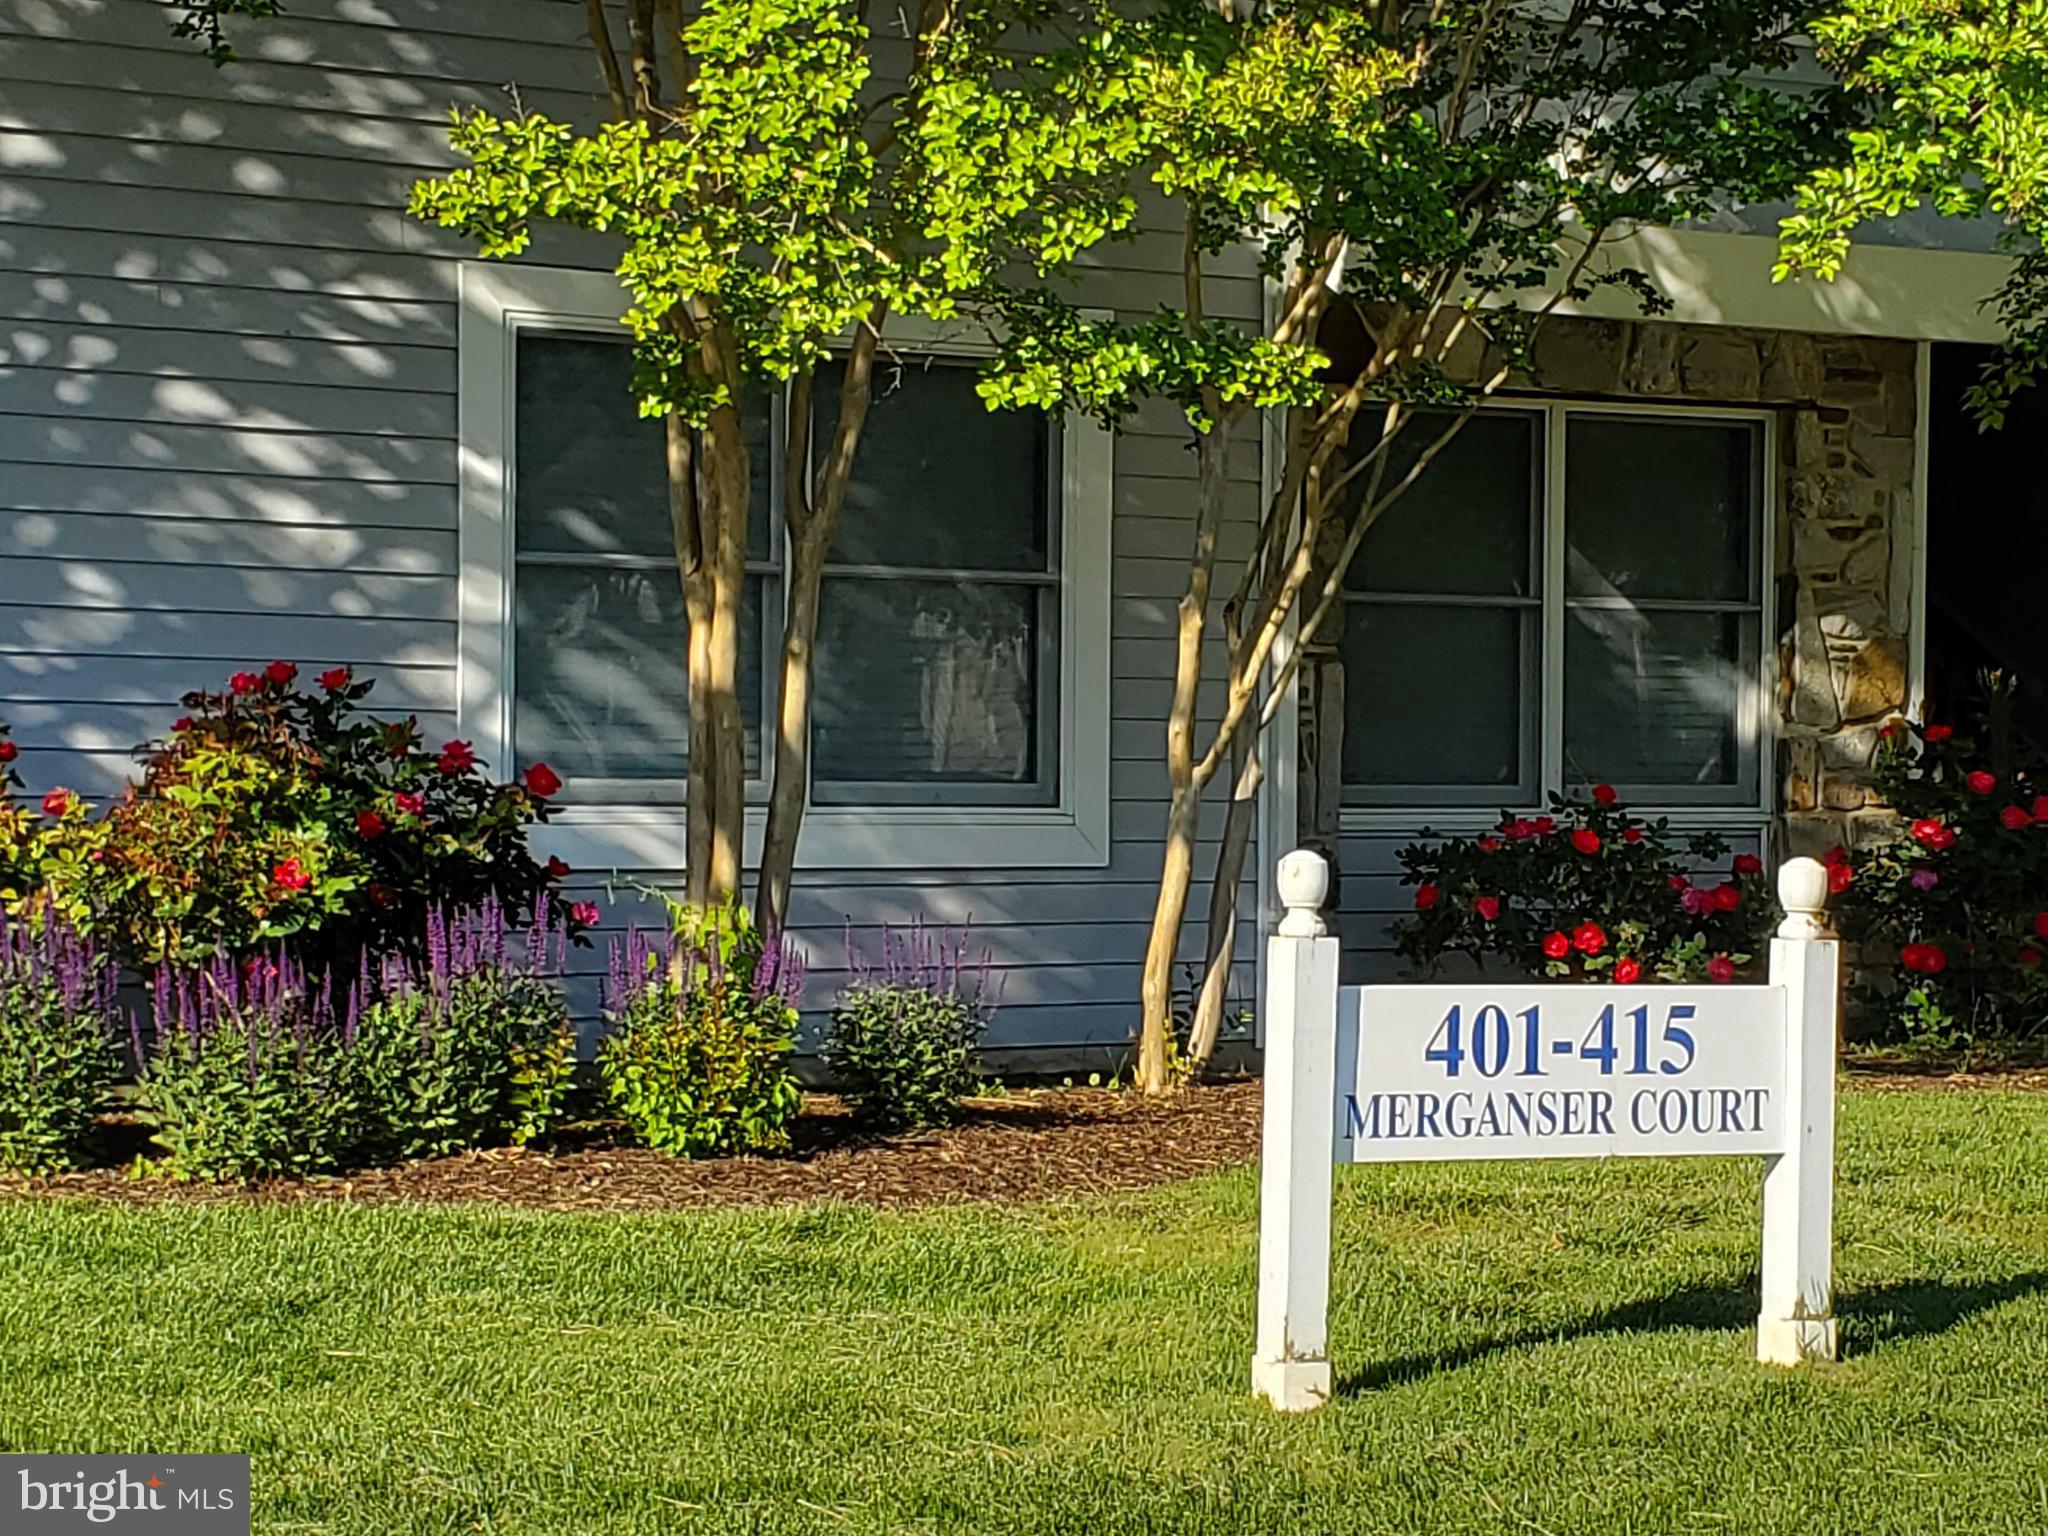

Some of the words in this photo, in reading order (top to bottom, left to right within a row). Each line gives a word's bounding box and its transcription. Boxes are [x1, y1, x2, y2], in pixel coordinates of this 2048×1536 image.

[1424, 1002, 1697, 1078] 401-415
[1342, 1090, 1616, 1140] MERGANSER
[1631, 1088, 1770, 1134] COURT
